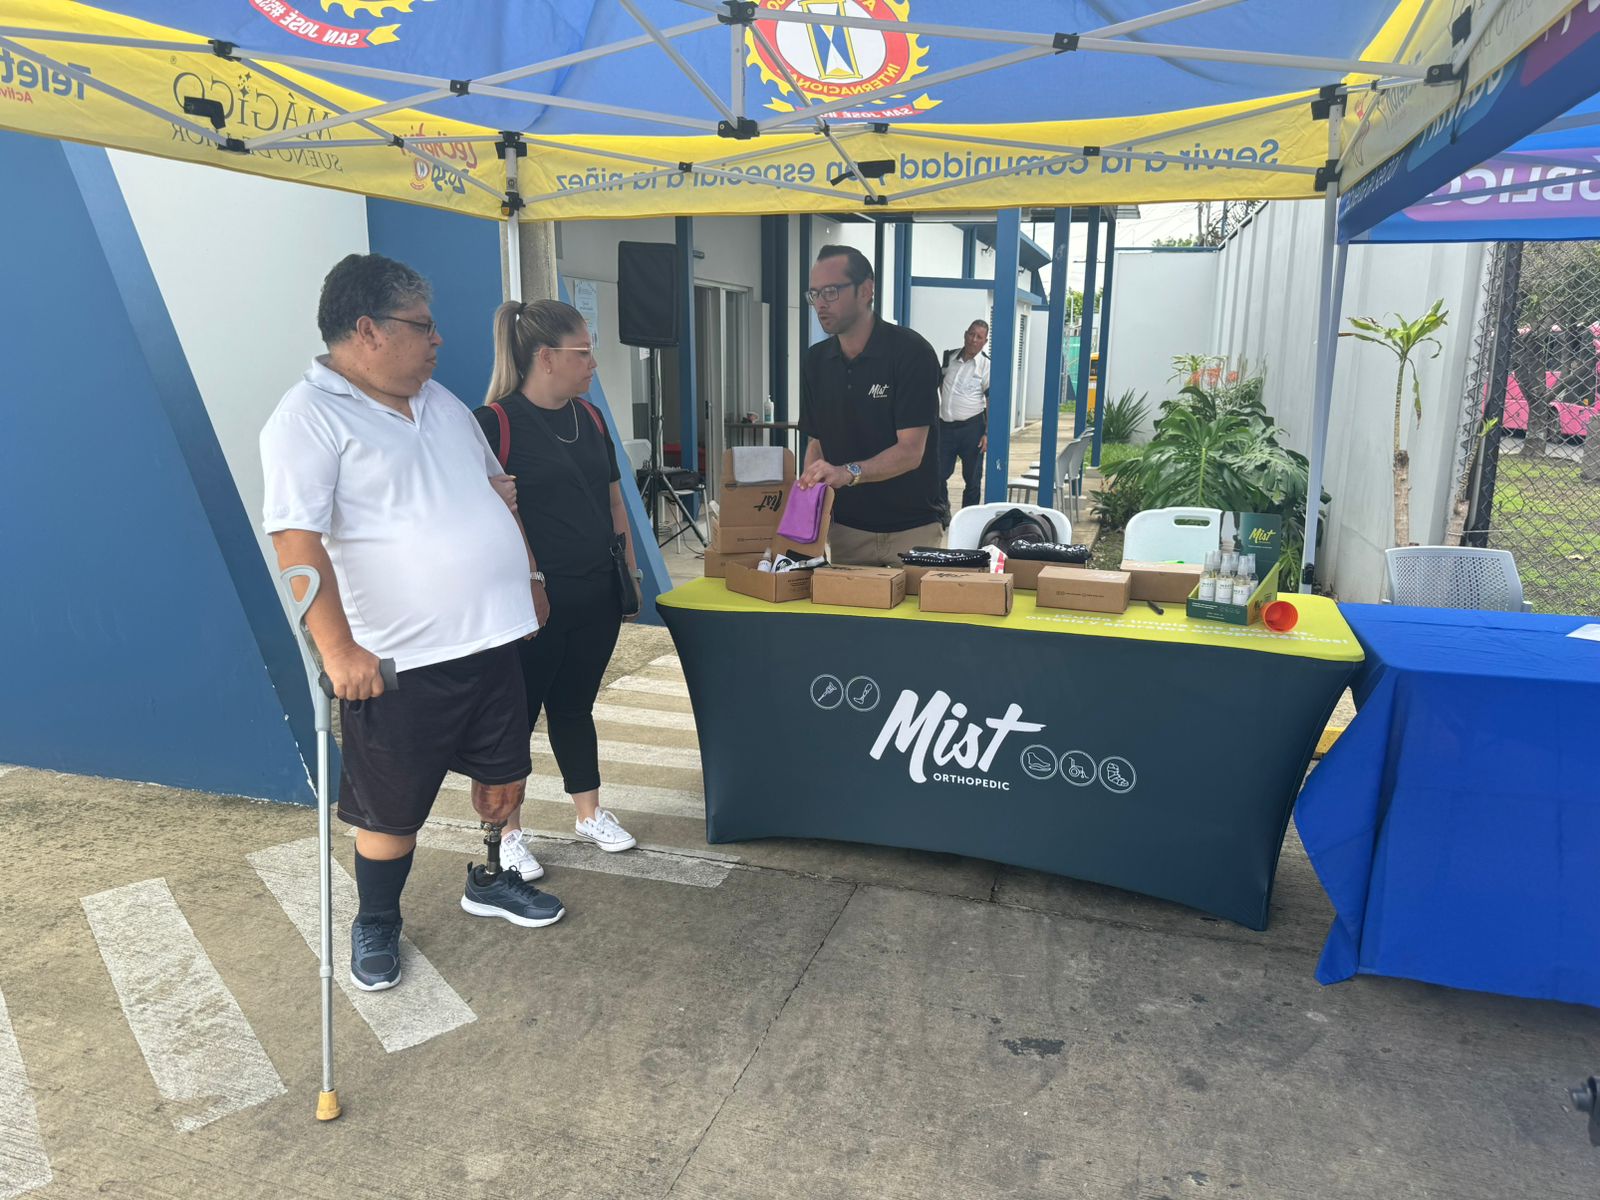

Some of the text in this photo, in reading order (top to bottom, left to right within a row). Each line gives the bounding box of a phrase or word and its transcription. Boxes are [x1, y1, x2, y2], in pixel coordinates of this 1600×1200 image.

[868, 384, 889, 399] Mist
[1248, 527, 1277, 544] Mist
[869, 689, 1047, 783] Mist
[933, 772, 1010, 791] ORTHOPEDIC
